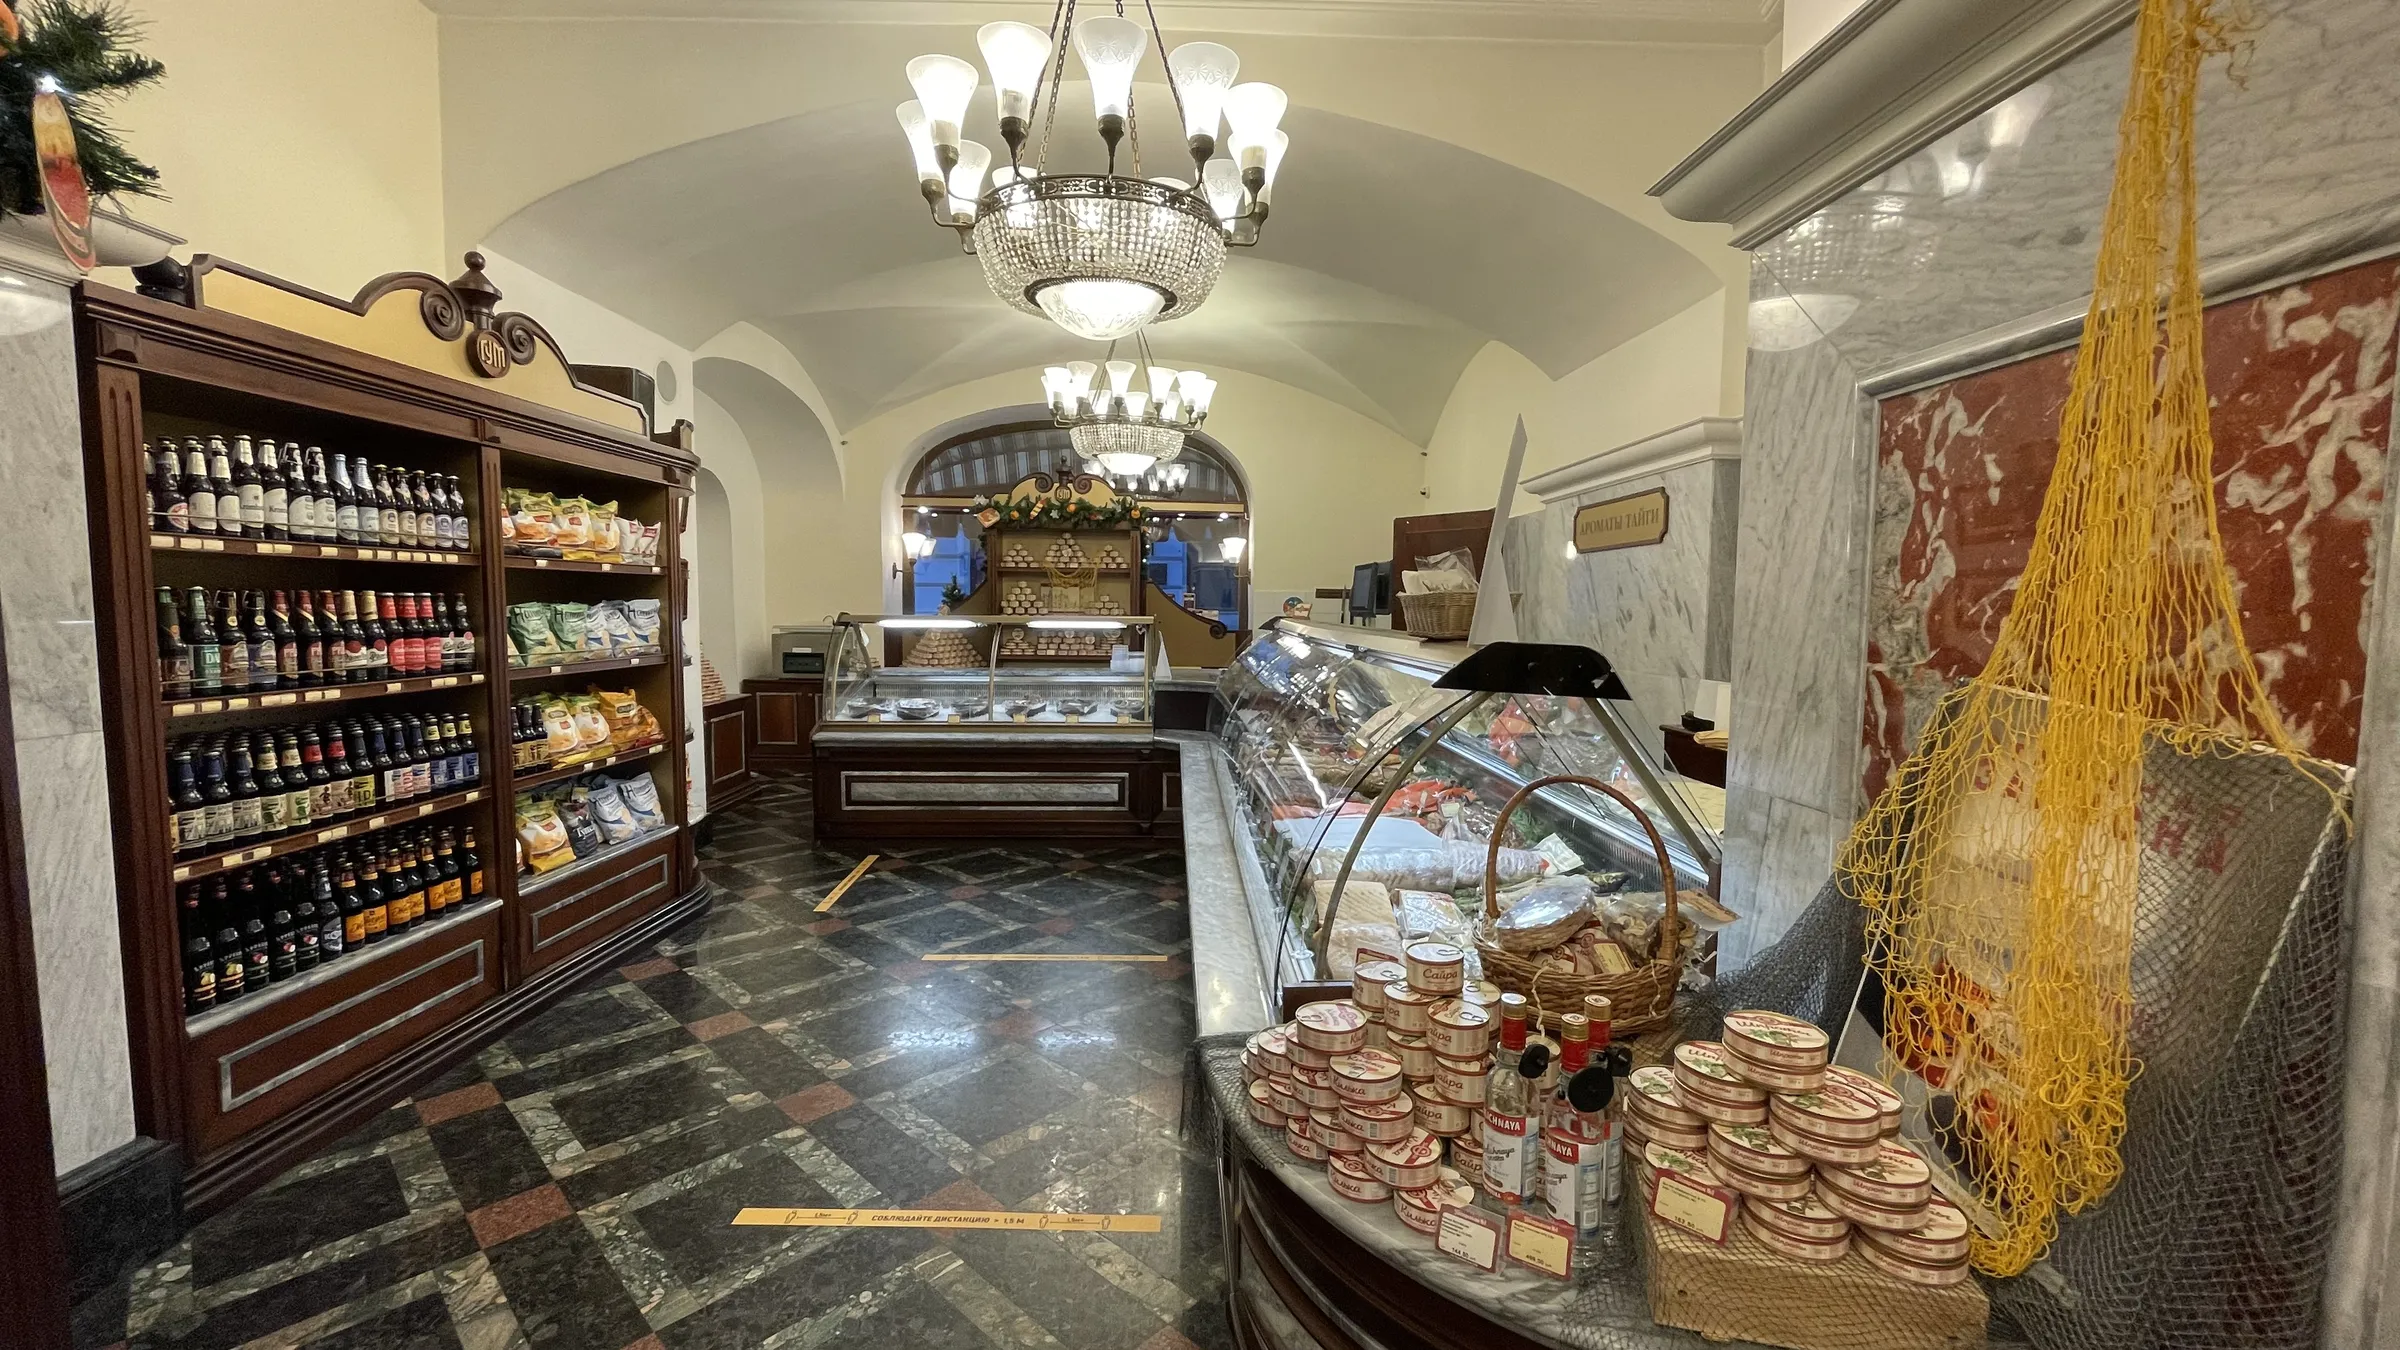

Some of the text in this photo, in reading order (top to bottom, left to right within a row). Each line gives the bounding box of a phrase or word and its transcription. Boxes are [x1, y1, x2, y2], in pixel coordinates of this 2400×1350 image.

[1579, 507, 1660, 536] АРОМАТЫ ТАЙГИ
[1422, 967, 1458, 981] Сайра
[1414, 1104, 1443, 1120] айра
[1454, 1151, 1482, 1173] Сайр
[871, 1214, 933, 1222] СОБЛЮДАЙТЕ
[933, 1215, 990, 1224] ДИСТАНЦИЮ
